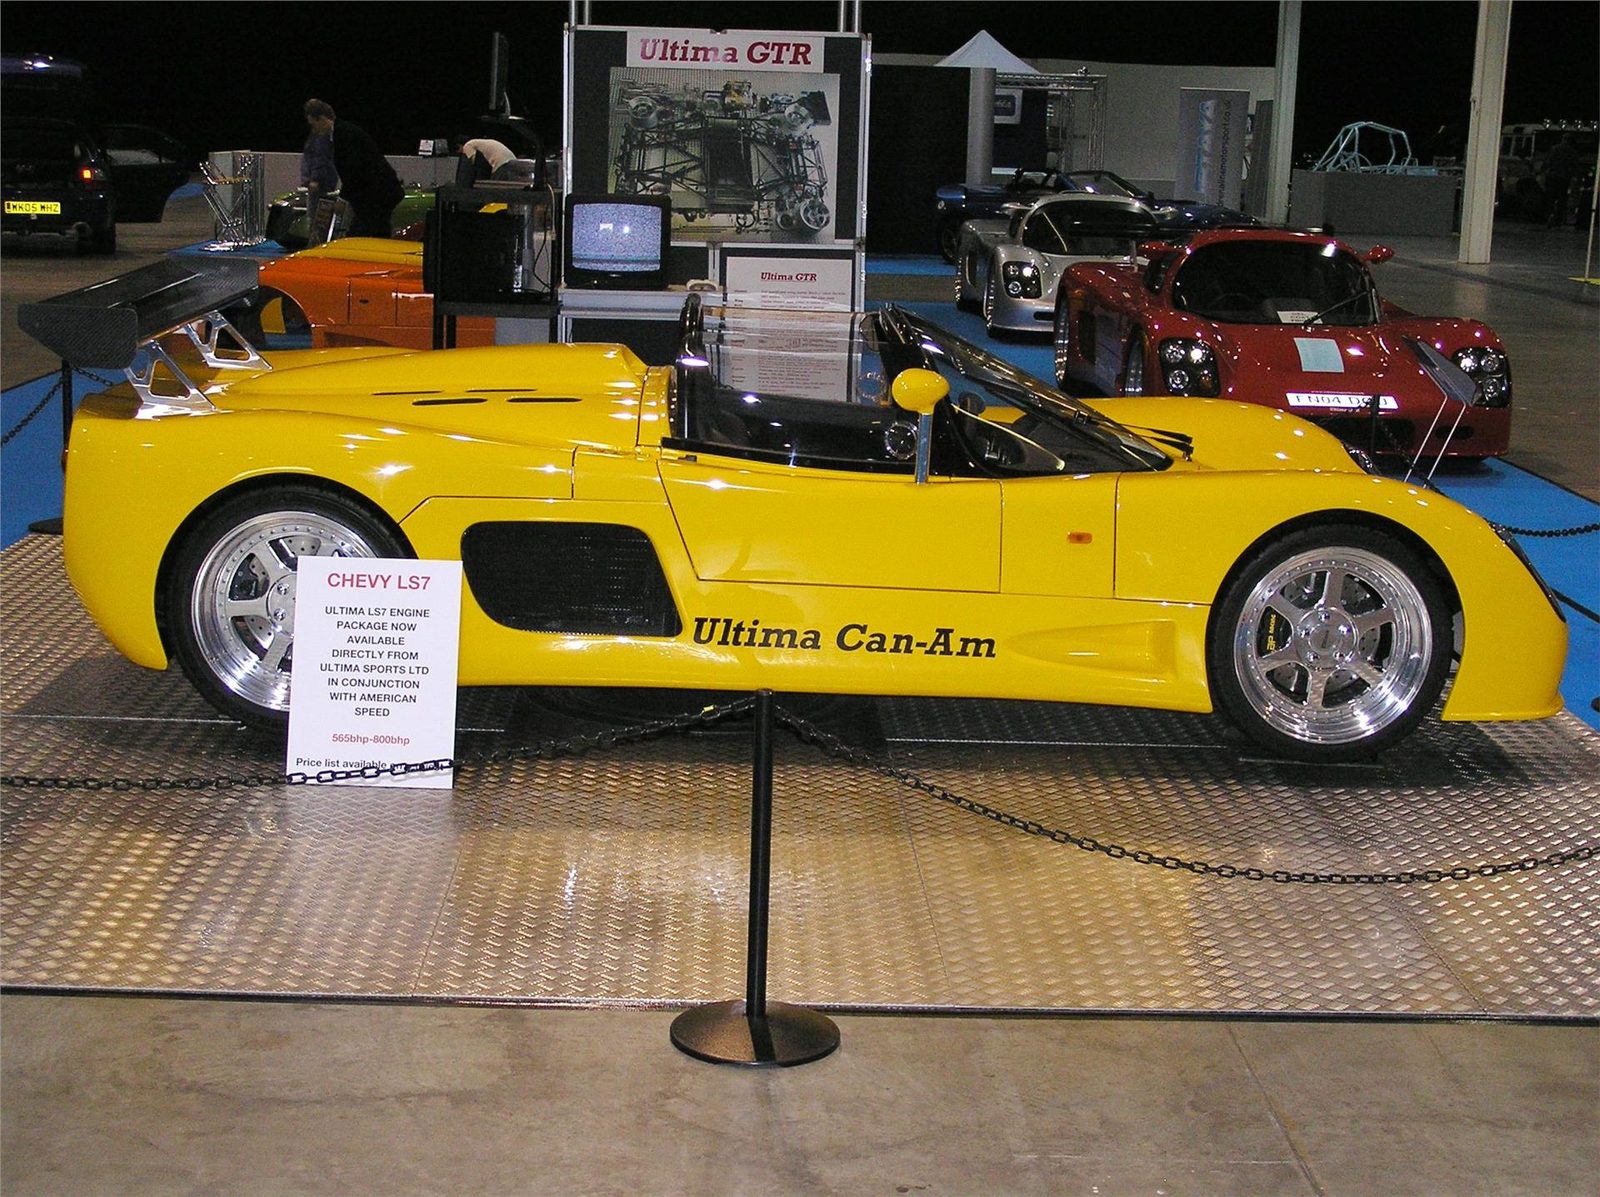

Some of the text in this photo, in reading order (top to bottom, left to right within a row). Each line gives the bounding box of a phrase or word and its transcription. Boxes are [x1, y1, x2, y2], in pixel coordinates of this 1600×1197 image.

[640, 38, 811, 65] Ultima GTR
[761, 272, 817, 282] Ultima GTR
[327, 573, 431, 590] CHEVY LS7
[325, 606, 430, 618] ULTIMA LS7 ENGINE
[336, 621, 417, 631] PACKAGE NOW
[347, 636, 405, 646] AVAILABLE
[693, 617, 996, 658] Ultima Can-Am
[332, 649, 418, 660] DIRECTLY FROM
[320, 663, 430, 675] ULTIMA SPORTS LTD
[327, 678, 420, 689] IN CONJUNCTION
[329, 692, 417, 703] WITH AMERICAN
[355, 707, 390, 717] SPEED
[332, 733, 410, 746] 565bhp-800bhp
[296, 758, 322, 768] Price
[325, 758, 338, 768] list
[342, 759, 387, 770] available
